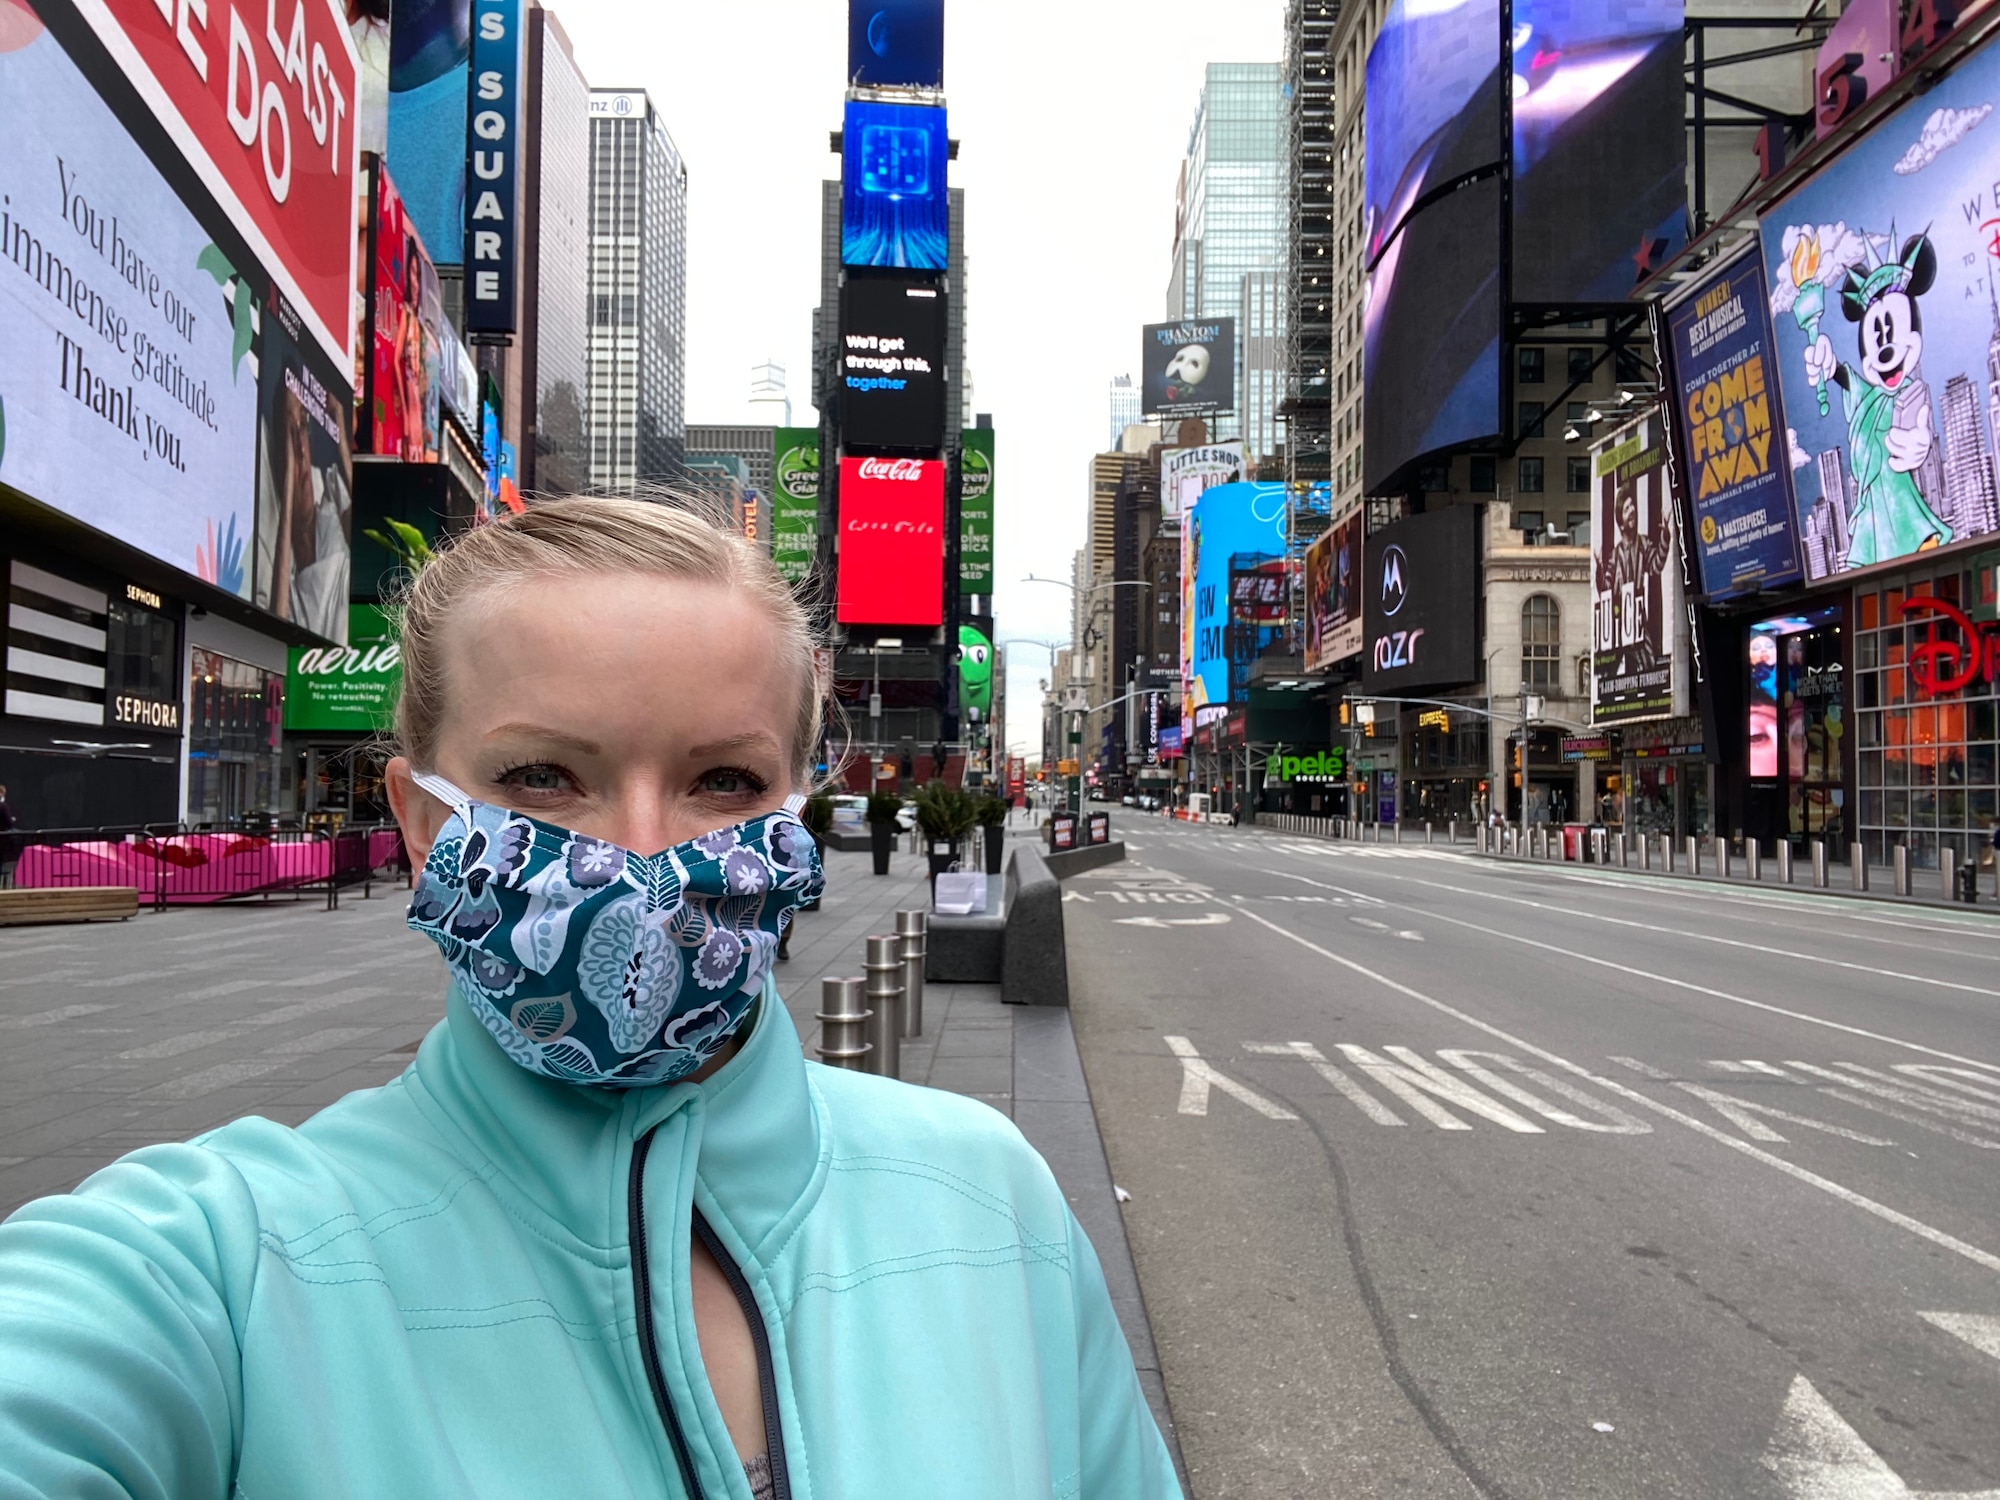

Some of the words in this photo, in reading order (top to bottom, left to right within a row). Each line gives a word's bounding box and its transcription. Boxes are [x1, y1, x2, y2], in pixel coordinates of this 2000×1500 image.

[227, 3, 291, 203] DO
[471, 71, 506, 300] SQUARE
[56, 154, 103, 255] You
[112, 216, 160, 308] have
[164, 290, 196, 344] our
[1963, 252, 1976, 268] TO
[1965, 278, 1984, 299] AT
[1, 194, 128, 352] immense
[132, 331, 219, 433] gratitude.
[1689, 317, 1708, 346] BEST
[1708, 294, 1744, 334] MUSICAL
[879, 337, 905, 353] get
[1157, 325, 1219, 341] PHANTOM
[845, 355, 901, 373] through
[1685, 374, 1706, 393] COME
[1707, 349, 1748, 379] TOGETHER
[1749, 341, 1760, 356] AT
[845, 376, 907, 391] together
[1688, 354, 1764, 425] COME
[56, 330, 139, 442] Thank
[143, 412, 186, 473] you.
[1692, 392, 1770, 464] FROM
[784, 469, 819, 482] Gree
[1170, 449, 1208, 473] LITTLE
[1212, 449, 1240, 467] SHOP
[1698, 430, 1771, 500] AWAY
[961, 473, 988, 482] een
[962, 482, 988, 494] iant
[961, 534, 989, 543] DING
[961, 543, 989, 552] RICA
[127, 584, 161, 609] SEPHORA
[297, 634, 400, 675] aerie
[1374, 628, 1424, 672] razr
[115, 696, 177, 728] SEPHORA
[1282, 745, 1344, 781] pelé
